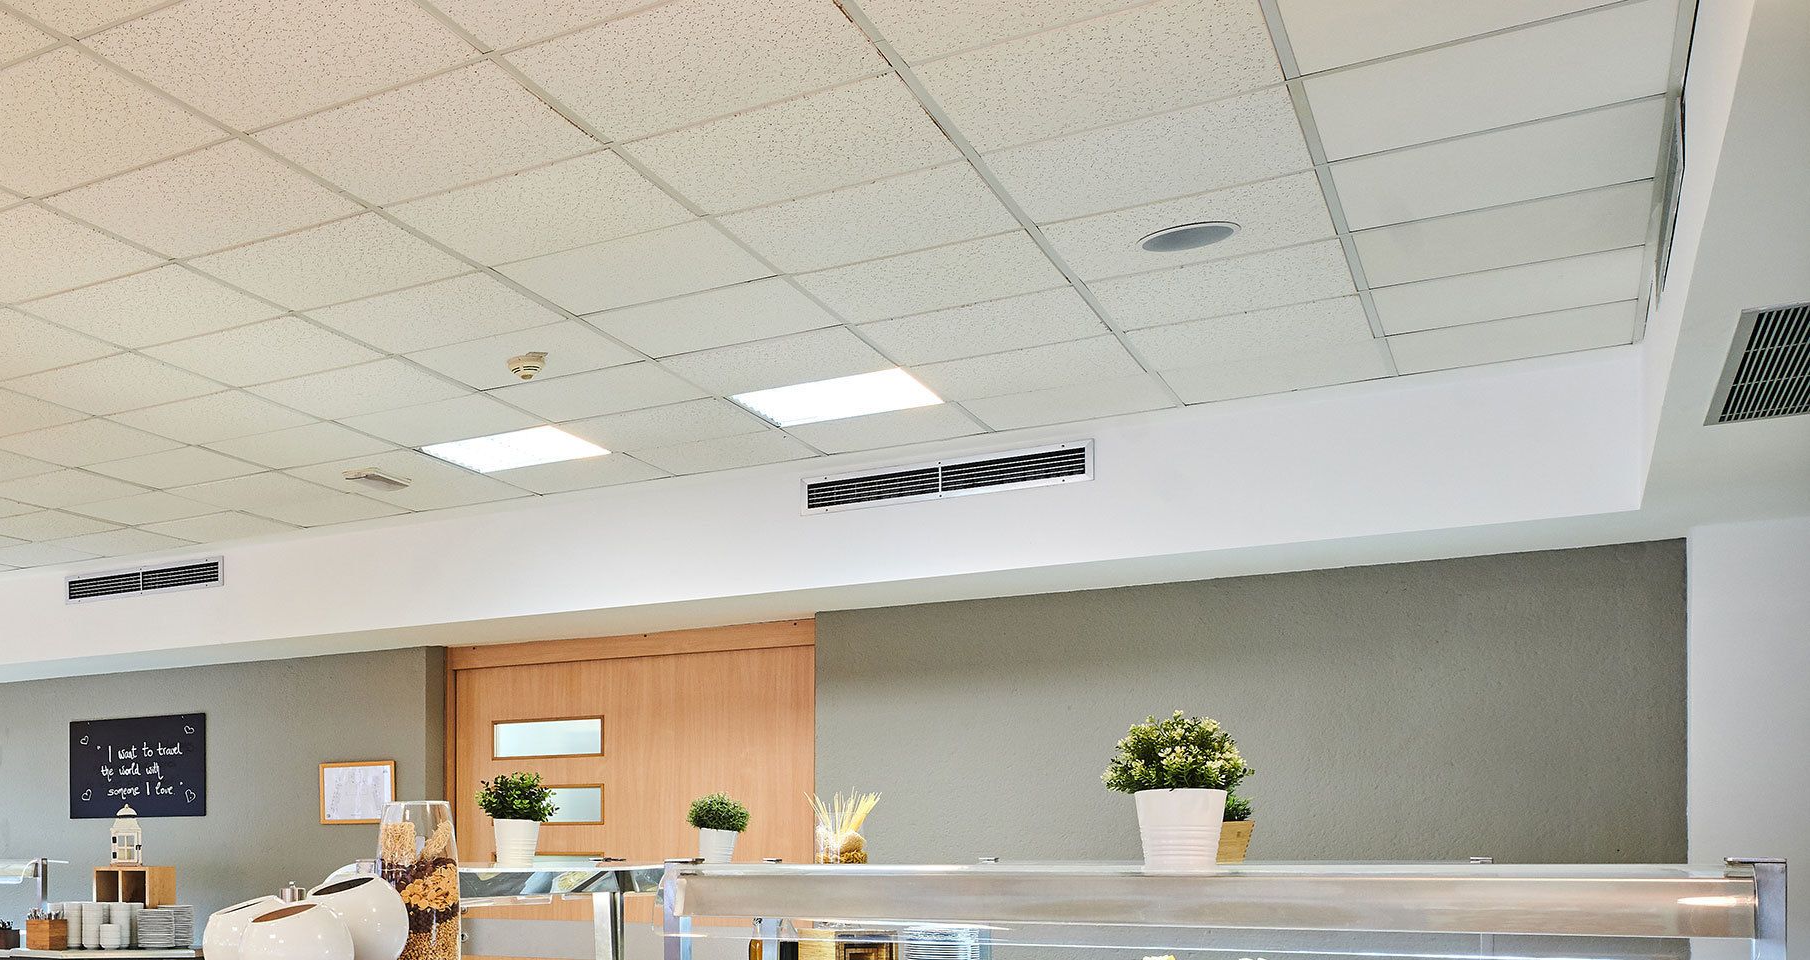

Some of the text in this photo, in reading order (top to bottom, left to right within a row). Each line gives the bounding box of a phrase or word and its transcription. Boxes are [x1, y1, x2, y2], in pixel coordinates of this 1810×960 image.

[118, 745, 137, 760] want
[142, 742, 153, 757] to
[157, 742, 183, 756] travel
[100, 761, 164, 782] the world with
[107, 786, 141, 800] someone
[146, 781, 150, 796] I
